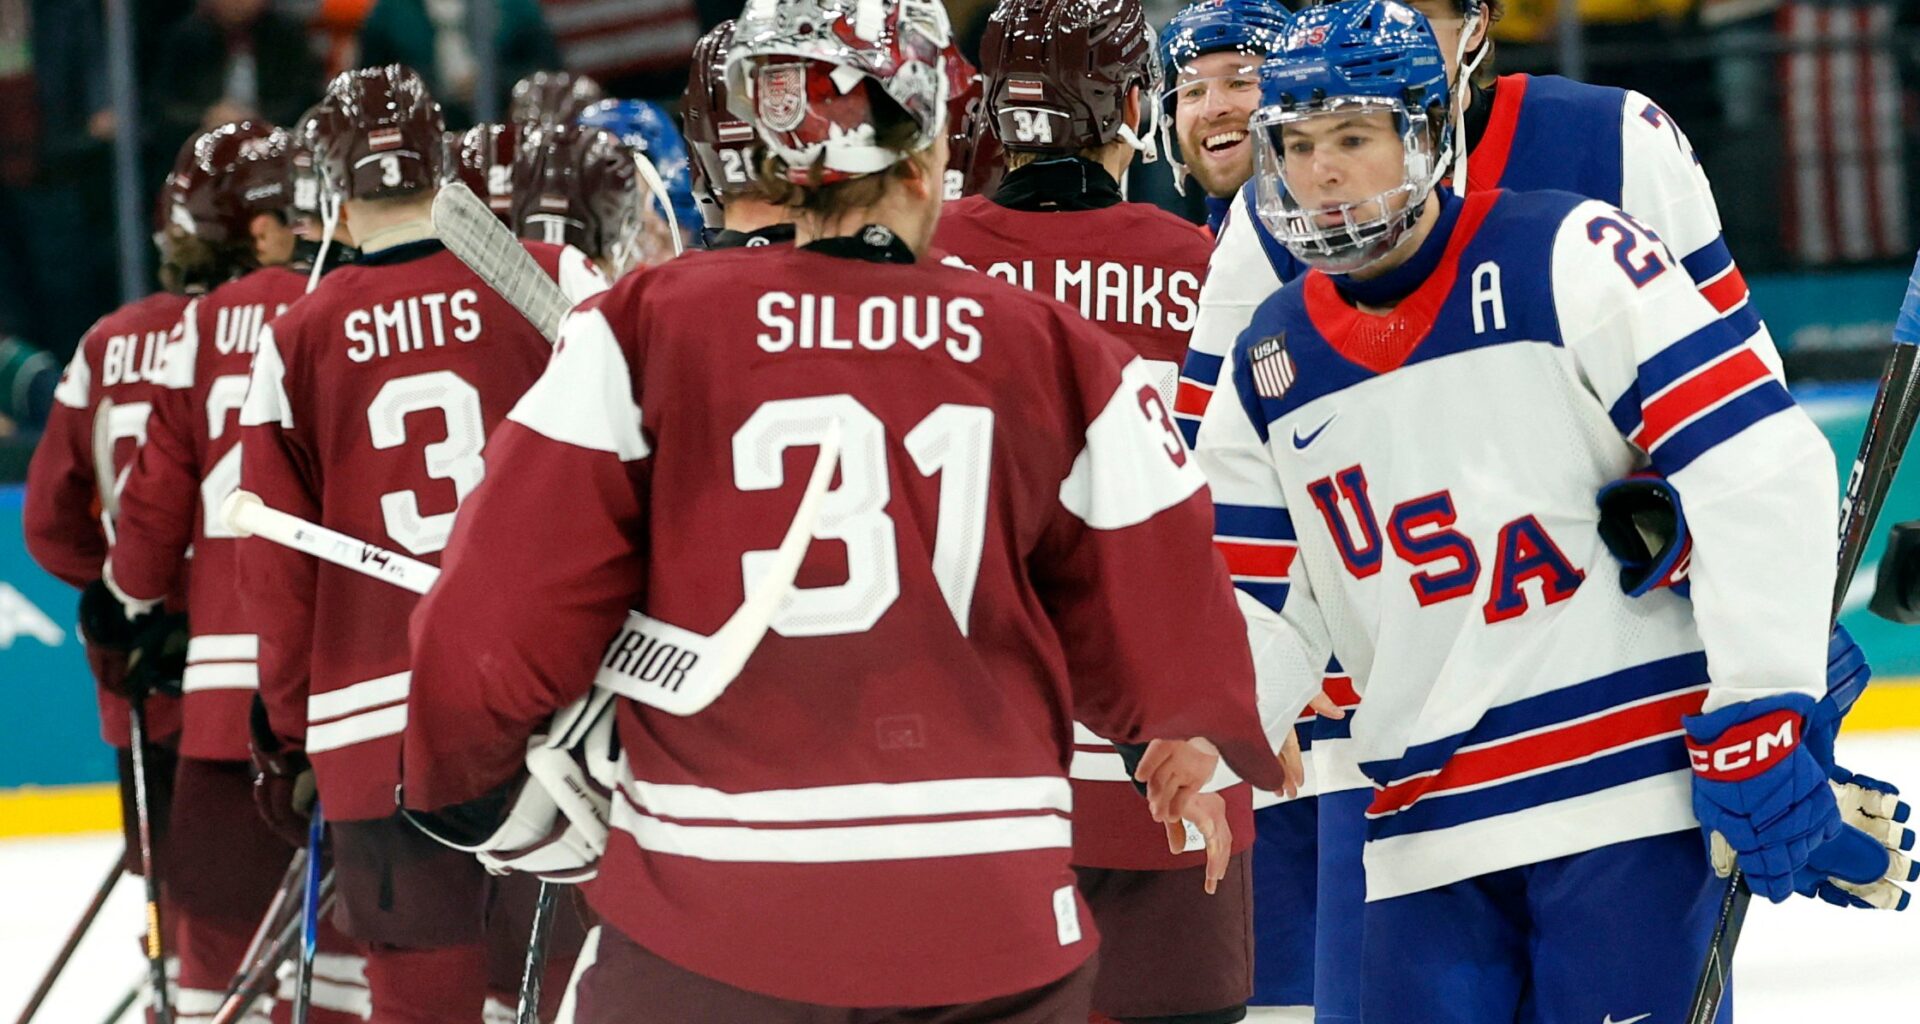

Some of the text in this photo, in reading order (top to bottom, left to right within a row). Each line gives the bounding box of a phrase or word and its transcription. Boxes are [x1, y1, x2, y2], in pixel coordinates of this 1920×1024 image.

[1013, 110, 1053, 143] 34
[380, 154, 401, 187] 3
[345, 289, 482, 362] SMITS
[757, 292, 985, 364] SILOVS
[940, 255, 1200, 332] MAKS
[1471, 260, 1506, 334] A
[102, 333, 168, 387] BLU
[1253, 338, 1280, 361] USA
[201, 375, 254, 538] 2
[367, 370, 486, 555] 3
[732, 394, 994, 638] 31
[1307, 463, 1585, 624] USA
[606, 630, 698, 692] RIOR
[1688, 719, 1793, 773] CCM
